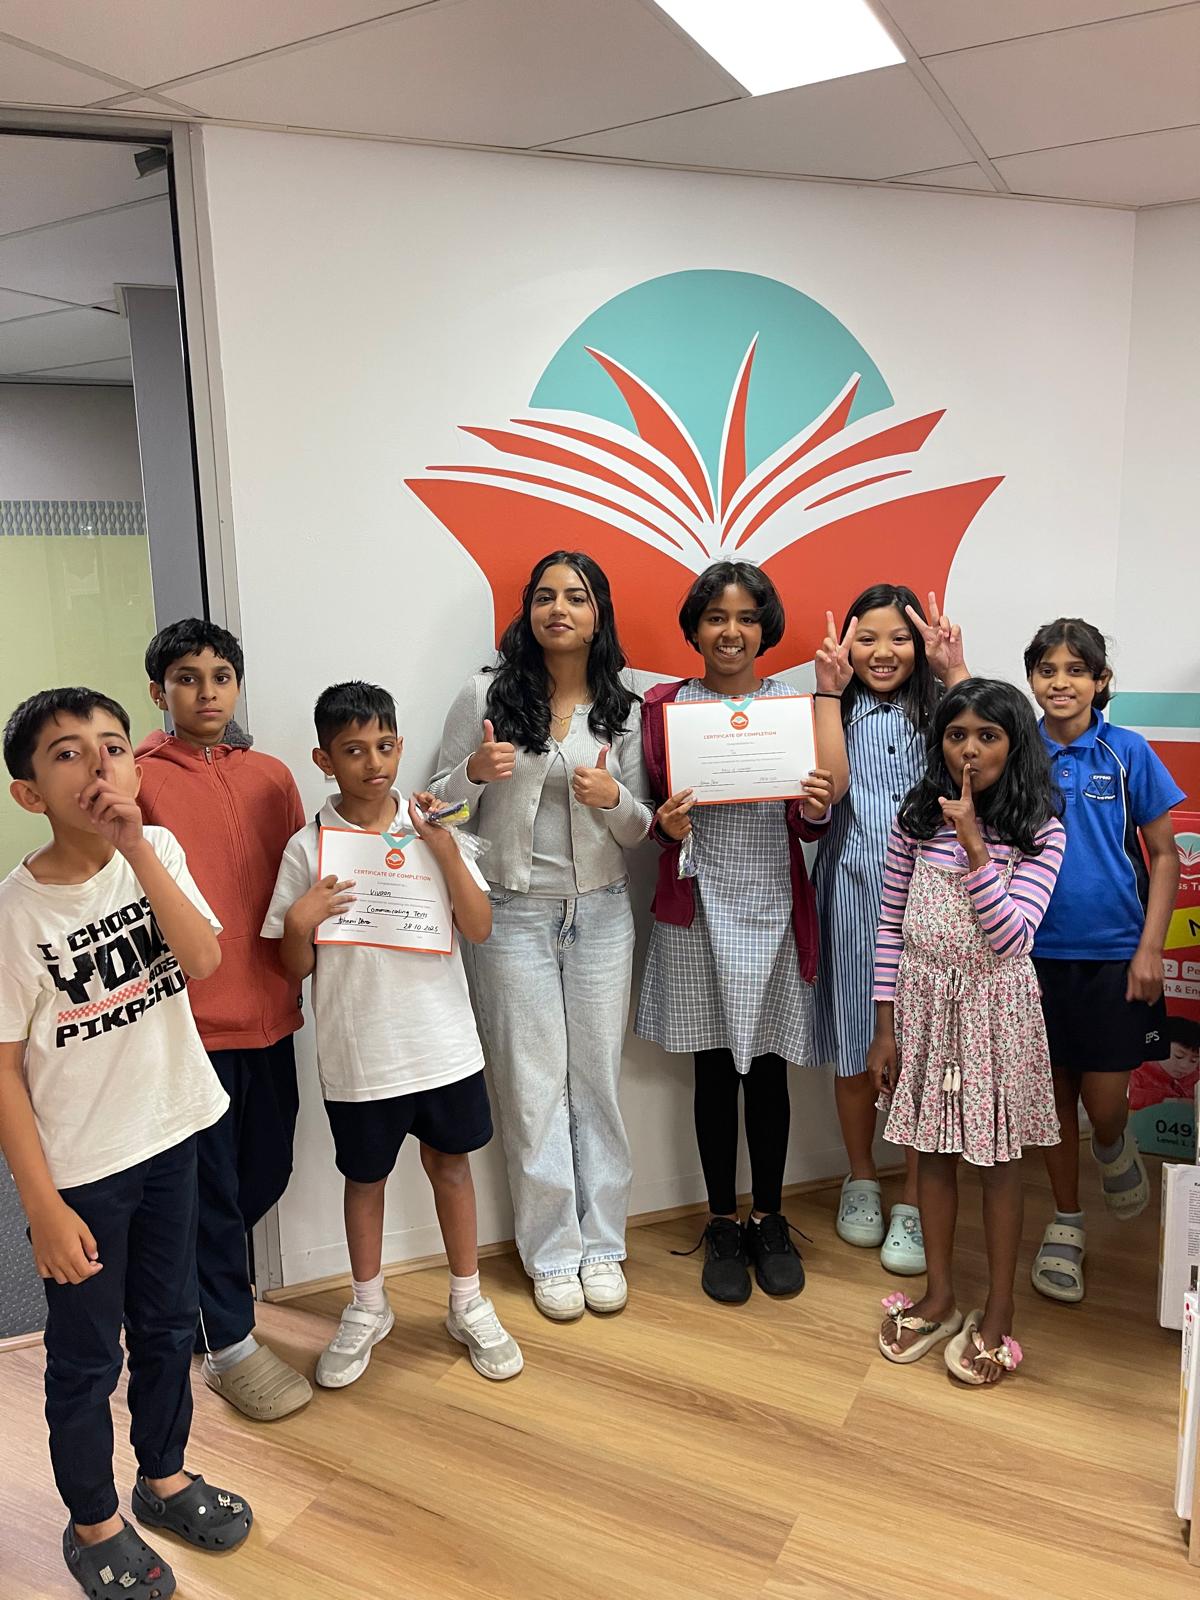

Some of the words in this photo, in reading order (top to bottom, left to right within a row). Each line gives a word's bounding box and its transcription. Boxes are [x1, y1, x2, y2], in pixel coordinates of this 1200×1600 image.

[353, 868, 387, 877] CERTIFICATE
[397, 873, 431, 881] COMPLETION
[37, 943, 60, 961] I
[67, 895, 150, 951] CHOOS
[1185, 986, 1200, 996] En
[1145, 1030, 1160, 1044] EPS
[1156, 1119, 1192, 1137] 049
